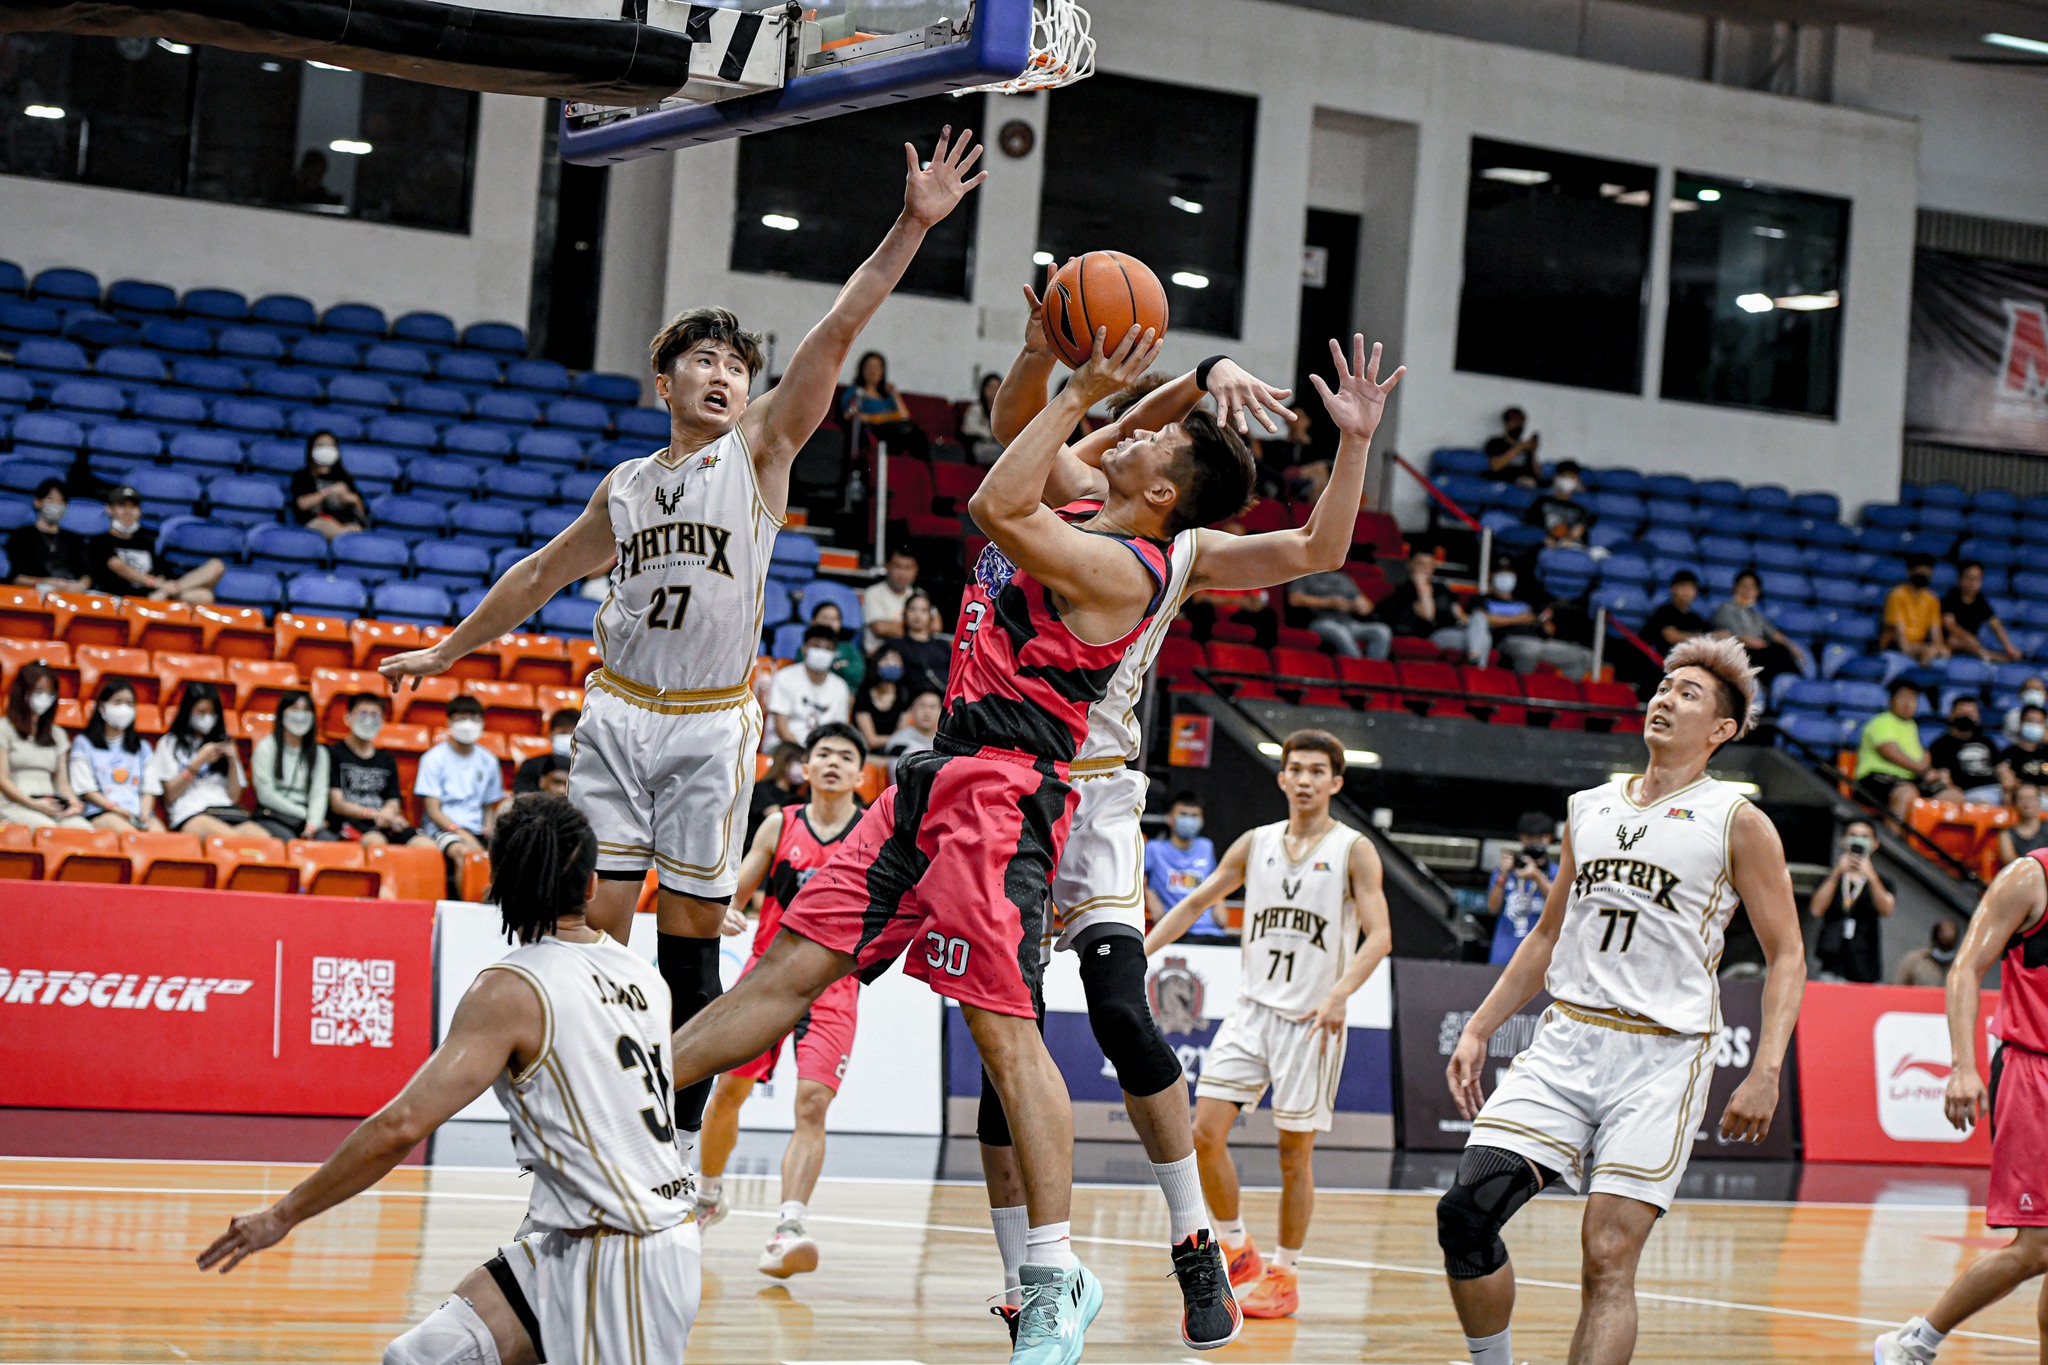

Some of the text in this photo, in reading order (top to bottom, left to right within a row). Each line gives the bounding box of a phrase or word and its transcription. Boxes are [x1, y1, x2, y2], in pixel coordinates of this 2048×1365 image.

[619, 522, 734, 584] MATRIX
[647, 584, 692, 631] 27
[1249, 907, 1328, 953] MATRIX
[1598, 908, 1639, 953] 77
[926, 930, 972, 977] 30
[1267, 949, 1295, 982] 71
